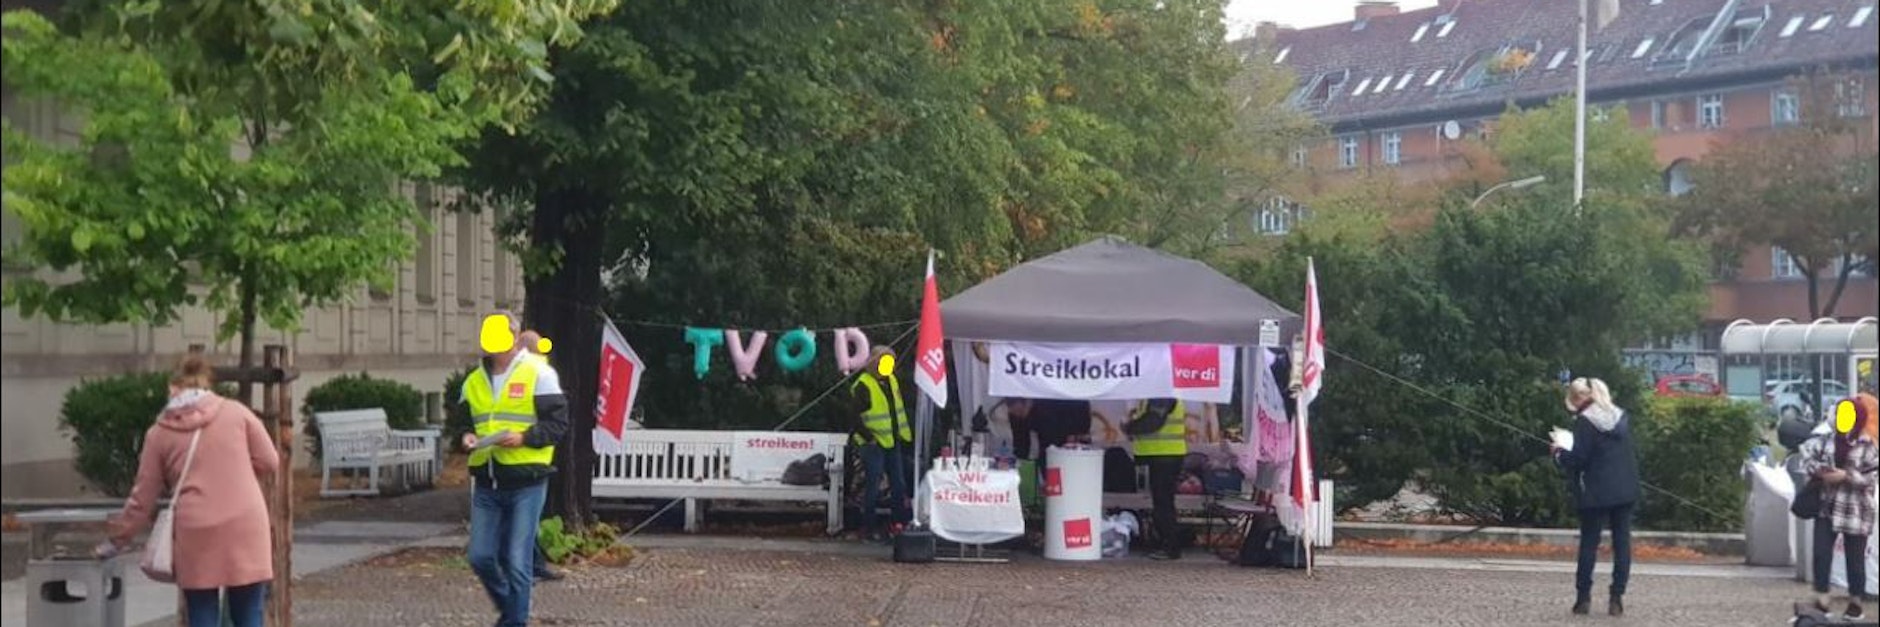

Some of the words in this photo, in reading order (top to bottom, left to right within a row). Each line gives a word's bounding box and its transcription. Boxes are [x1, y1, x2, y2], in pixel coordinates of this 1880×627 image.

[1004, 352, 1140, 379] Streiklokal
[747, 437, 814, 449] streiken!
[958, 472, 987, 483] Wir
[934, 488, 1010, 503] streiken!
